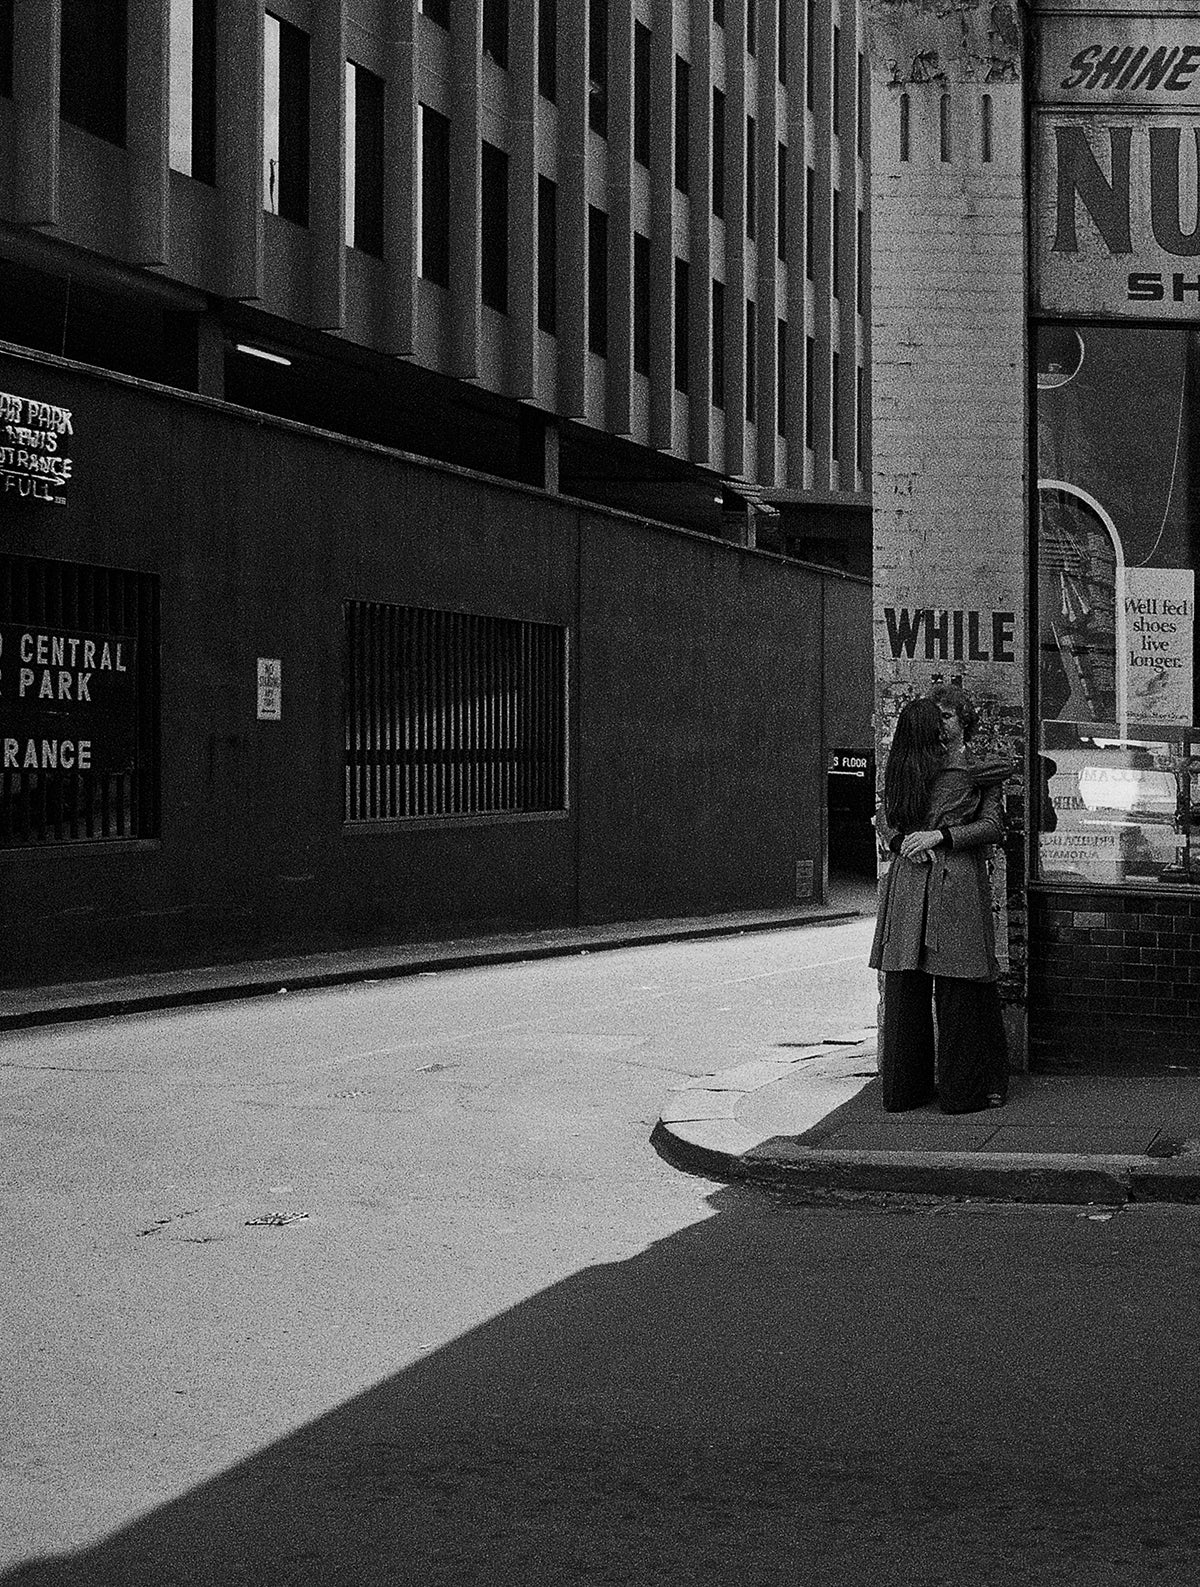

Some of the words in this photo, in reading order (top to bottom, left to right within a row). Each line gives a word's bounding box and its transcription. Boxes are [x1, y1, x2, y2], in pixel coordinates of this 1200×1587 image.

[27, 399, 74, 436] PARK
[1125, 599, 1157, 615] Well
[1163, 599, 1189, 616] fed
[883, 607, 1016, 663] WHILE
[1132, 616, 1177, 633] shoes
[20, 633, 128, 673] CENTRAL
[1141, 636, 1170, 652] live
[1130, 651, 1183, 673] longer.
[18, 667, 93, 702] PARK
[3, 737, 93, 770] RANCE
[842, 757, 867, 769] FLOOR
